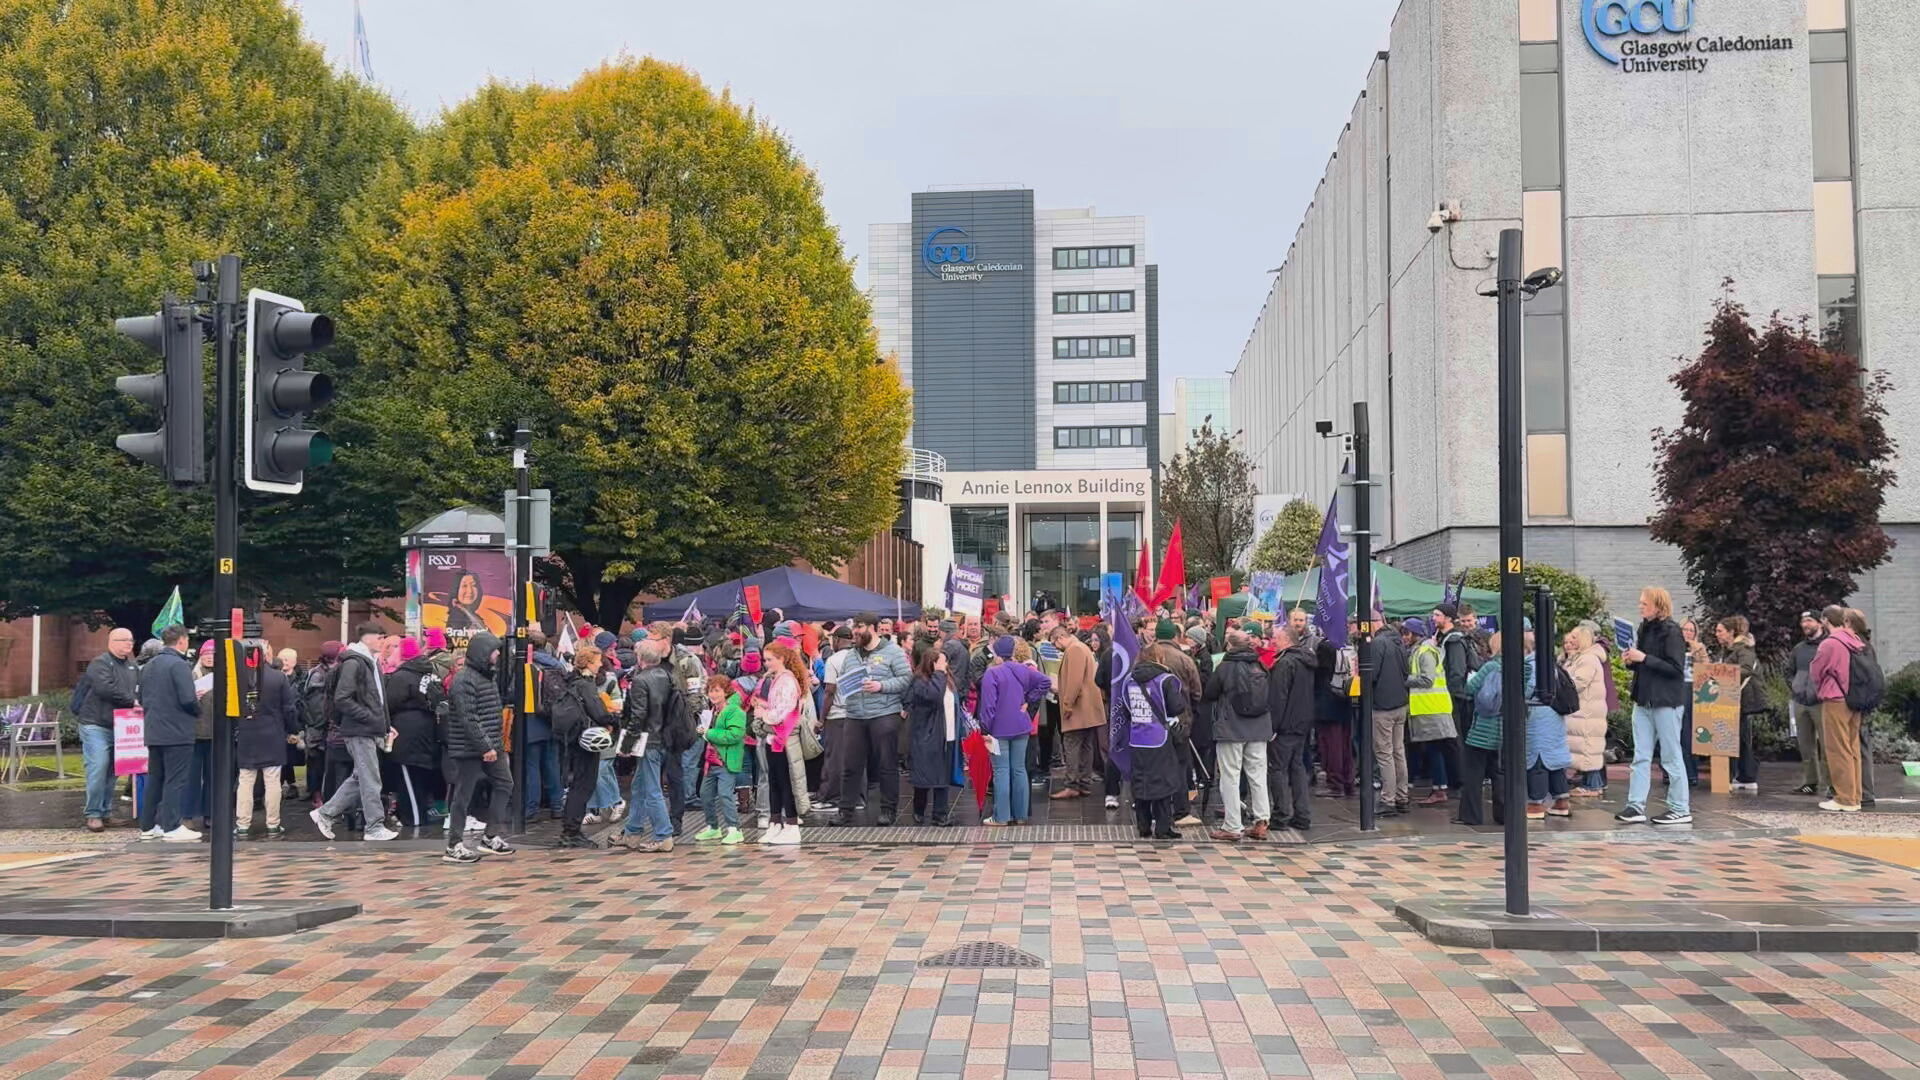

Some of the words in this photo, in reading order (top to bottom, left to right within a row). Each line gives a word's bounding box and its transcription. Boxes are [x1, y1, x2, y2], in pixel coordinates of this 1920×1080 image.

[1595, 0, 1694, 36] GCU
[1620, 40, 1692, 58] Glasgow
[1696, 35, 1793, 52] Caledonian
[1621, 56, 1708, 73] University
[928, 244, 975, 264] GCU
[941, 264, 976, 274] Glasgow
[977, 263, 1023, 272] Caledonian
[941, 273, 983, 281] University
[961, 480, 1009, 495] Annie
[1015, 480, 1072, 494] Lennox
[1078, 478, 1145, 496] Building
[223, 560, 231, 573] 5
[428, 555, 457, 565] RSNO
[1511, 558, 1519, 572] 2
[956, 569, 984, 584] OFFICIAL
[957, 581, 979, 594] PICKET
[126, 725, 140, 735] NO
